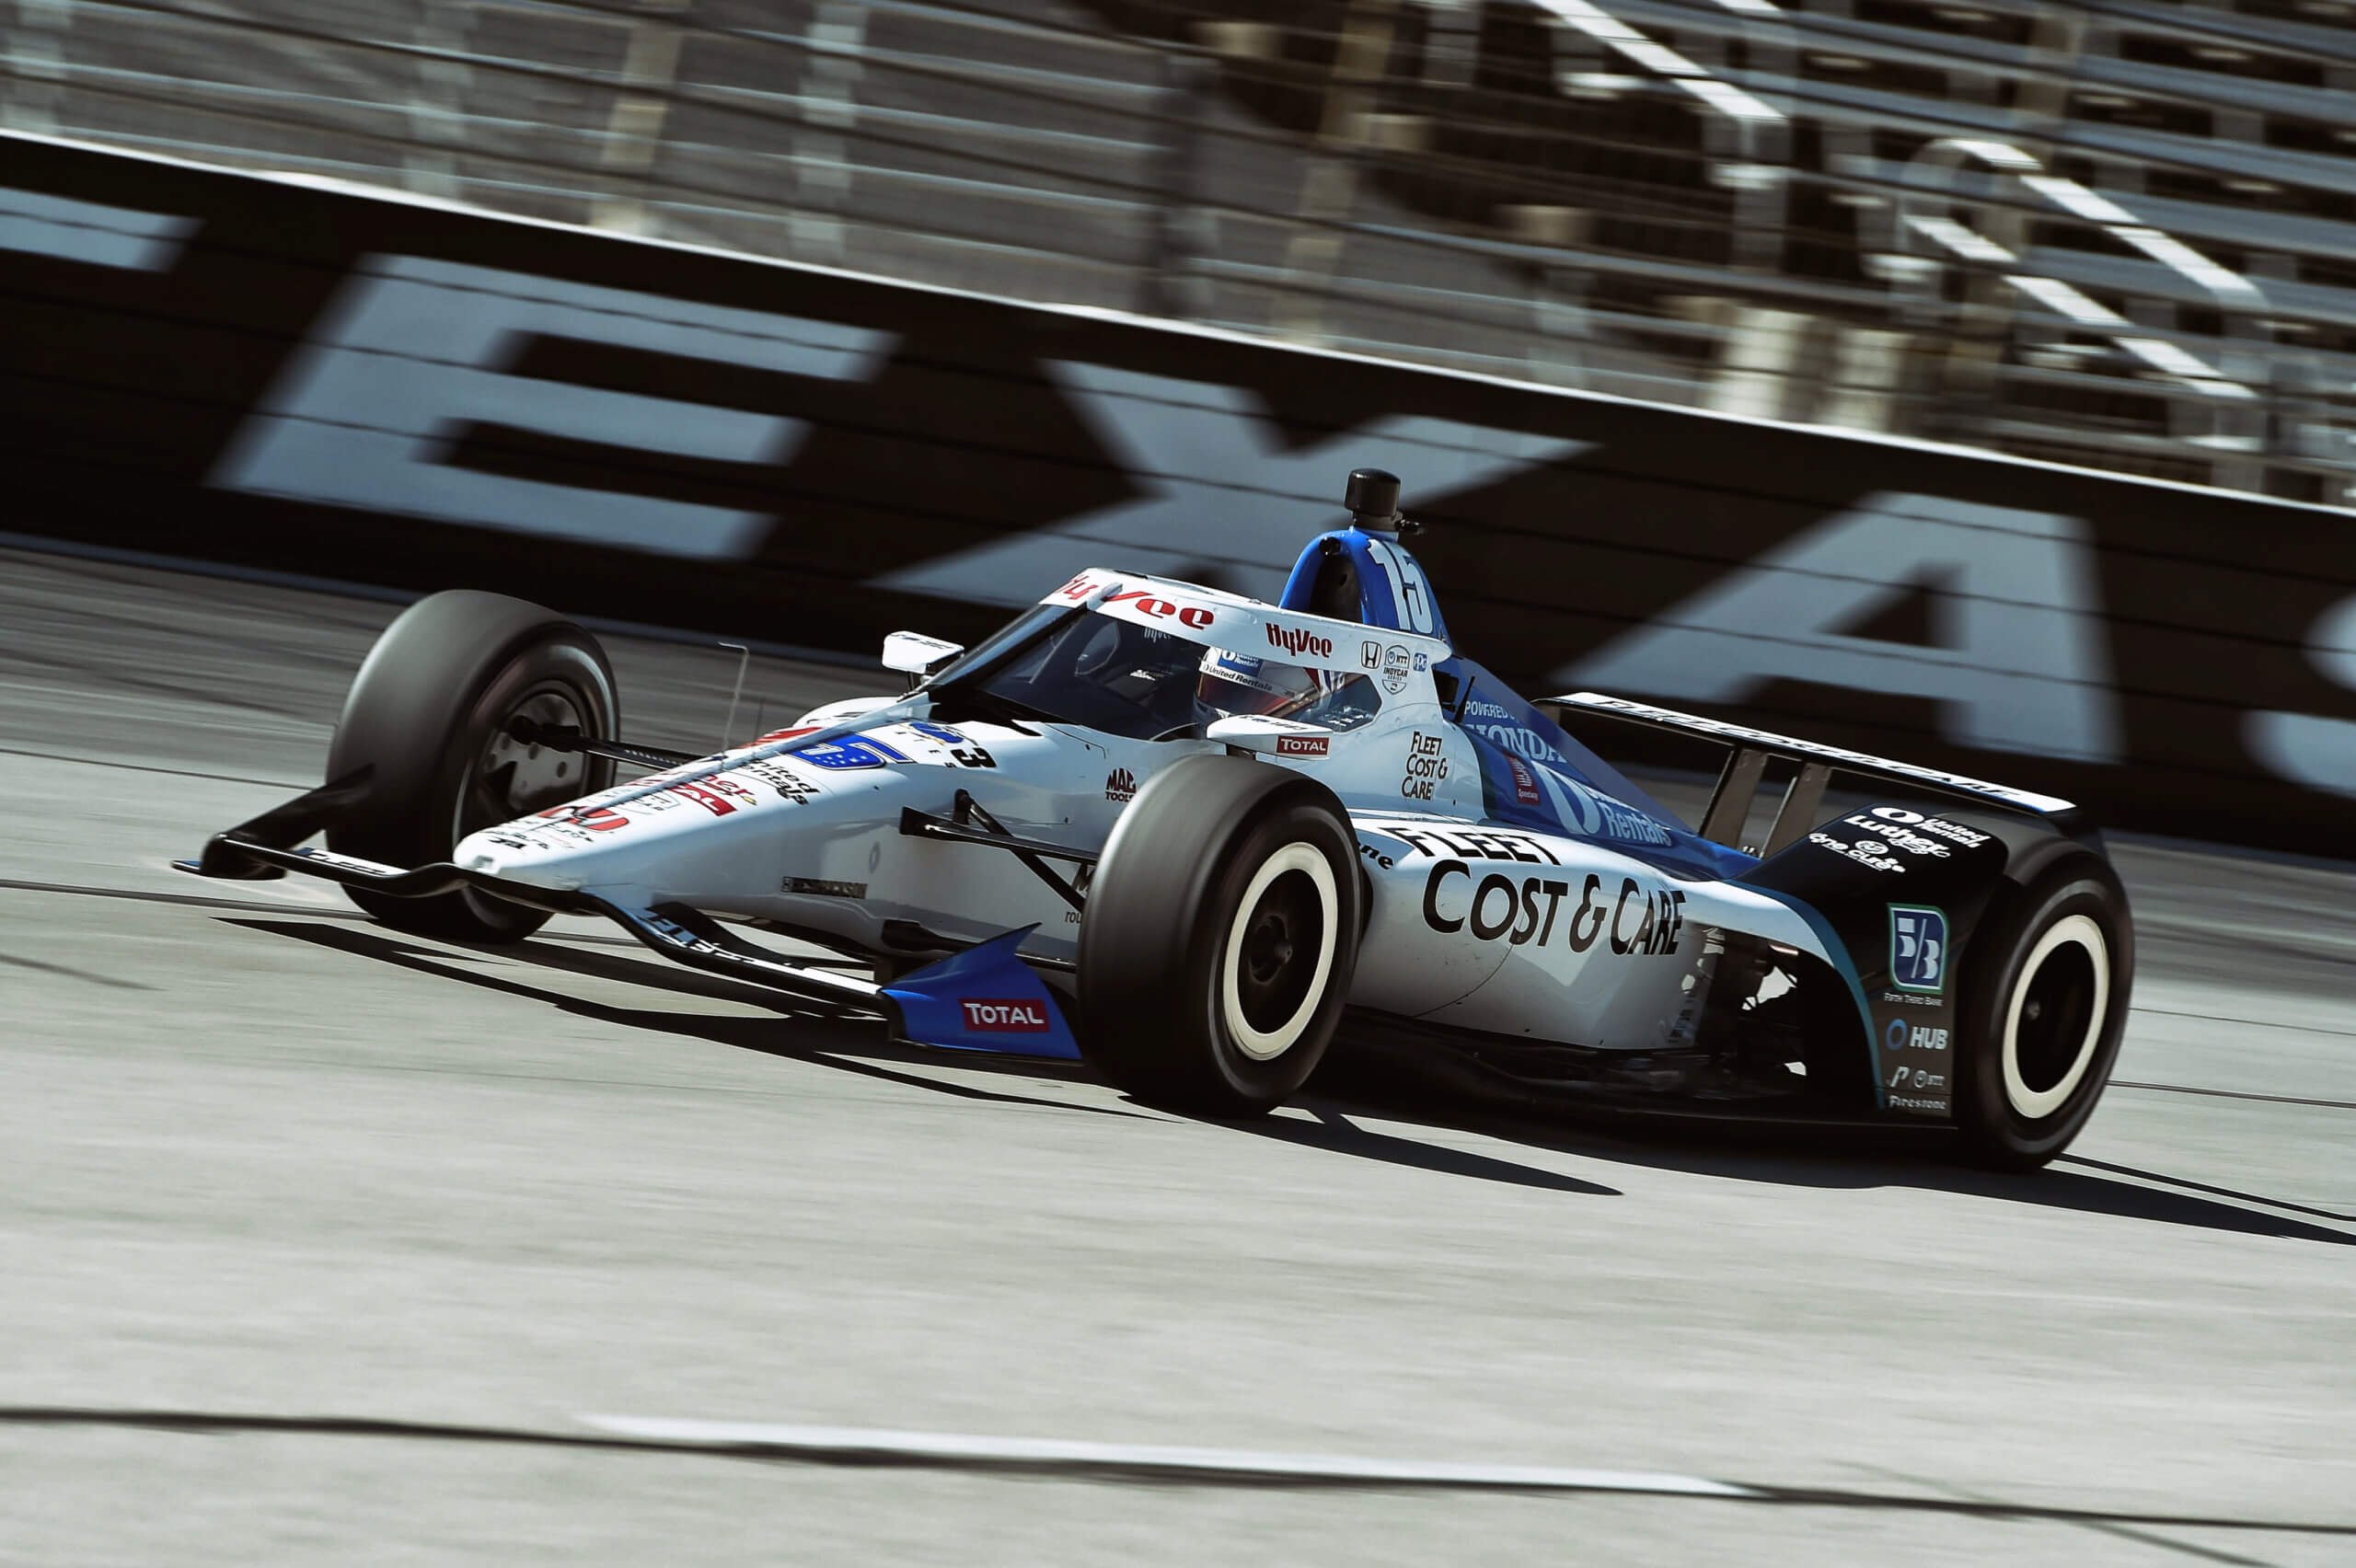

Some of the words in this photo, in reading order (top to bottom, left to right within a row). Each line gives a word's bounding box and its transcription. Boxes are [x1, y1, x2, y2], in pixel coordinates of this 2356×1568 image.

[1367, 538, 1434, 634] 15
[1265, 622, 1333, 659] HyVee
[1395, 654, 1408, 664] NTT
[1209, 664, 1235, 679] United
[1235, 674, 1274, 692] Rentals
[1383, 666, 1408, 678] INDYCAR
[1280, 738, 1326, 752] TOTAL
[1411, 731, 1443, 756] FLEET
[751, 757, 820, 794] nited
[1106, 767, 1138, 791] MAC
[1406, 753, 1438, 778] COST
[1438, 757, 1449, 780] &
[1401, 775, 1434, 801] CARE
[1914, 823, 1981, 848] Rentals
[1923, 818, 1992, 842] United
[1377, 826, 1563, 866] FLEET
[1422, 859, 1569, 947] COST
[1568, 873, 1608, 953] &
[1610, 877, 1687, 955] CARE
[964, 1003, 1045, 1025] TOTAL
[1909, 1026, 1949, 1050] HUB
